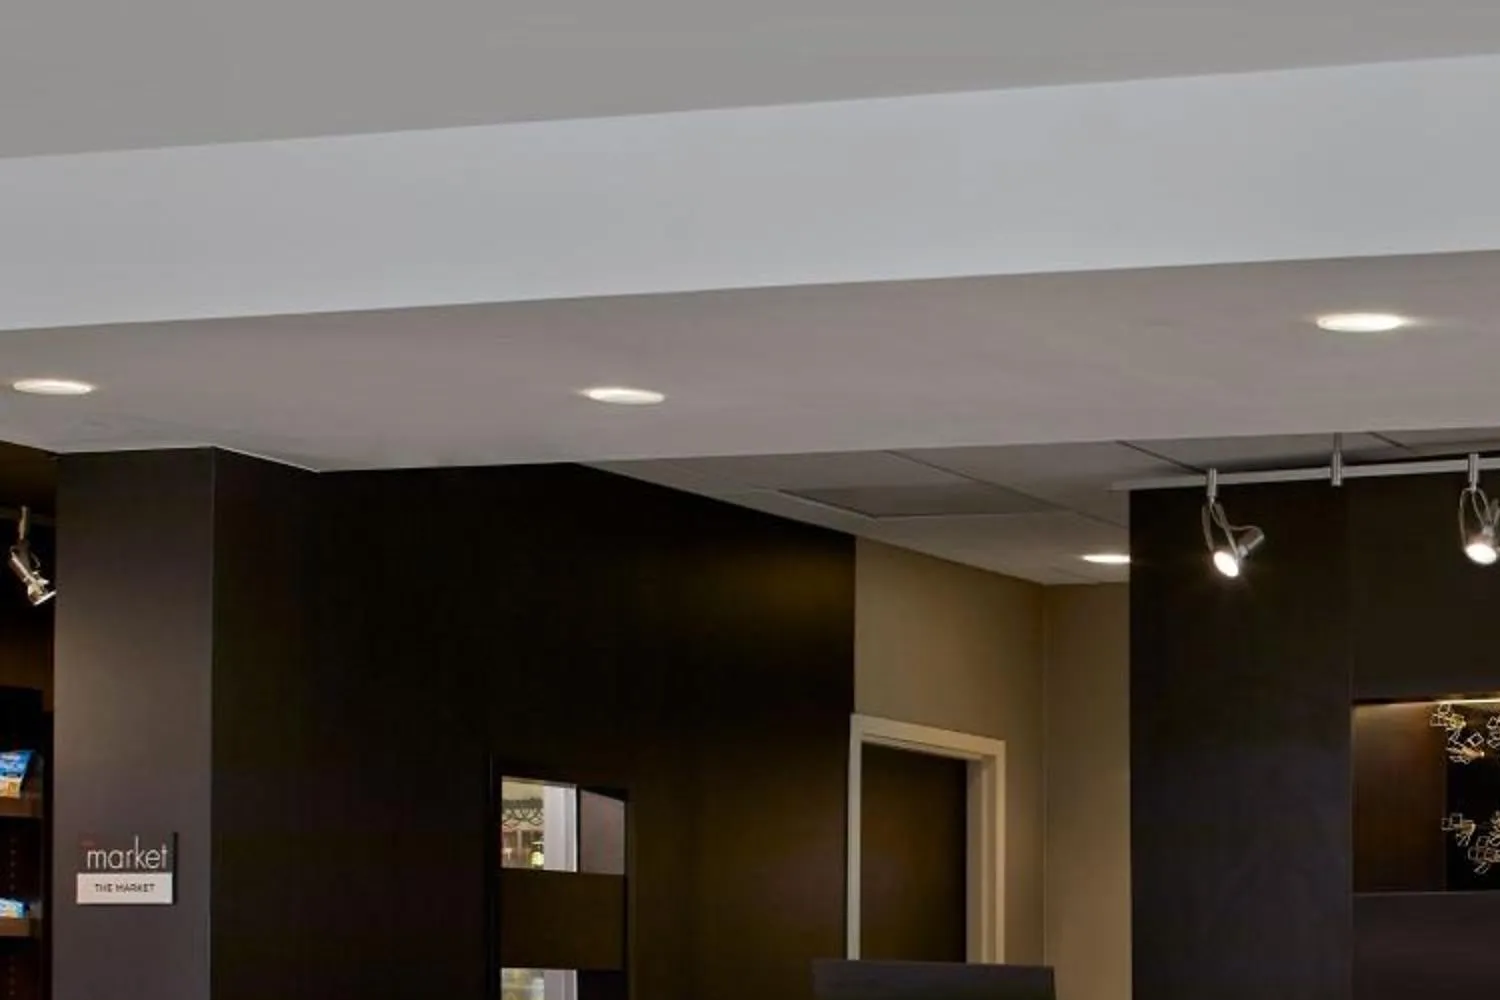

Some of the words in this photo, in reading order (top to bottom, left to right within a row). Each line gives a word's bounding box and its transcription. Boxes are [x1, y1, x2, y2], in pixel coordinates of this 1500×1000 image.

[87, 835, 168, 869] market
[95, 883, 113, 893] THE
[116, 883, 156, 893] MARKET
